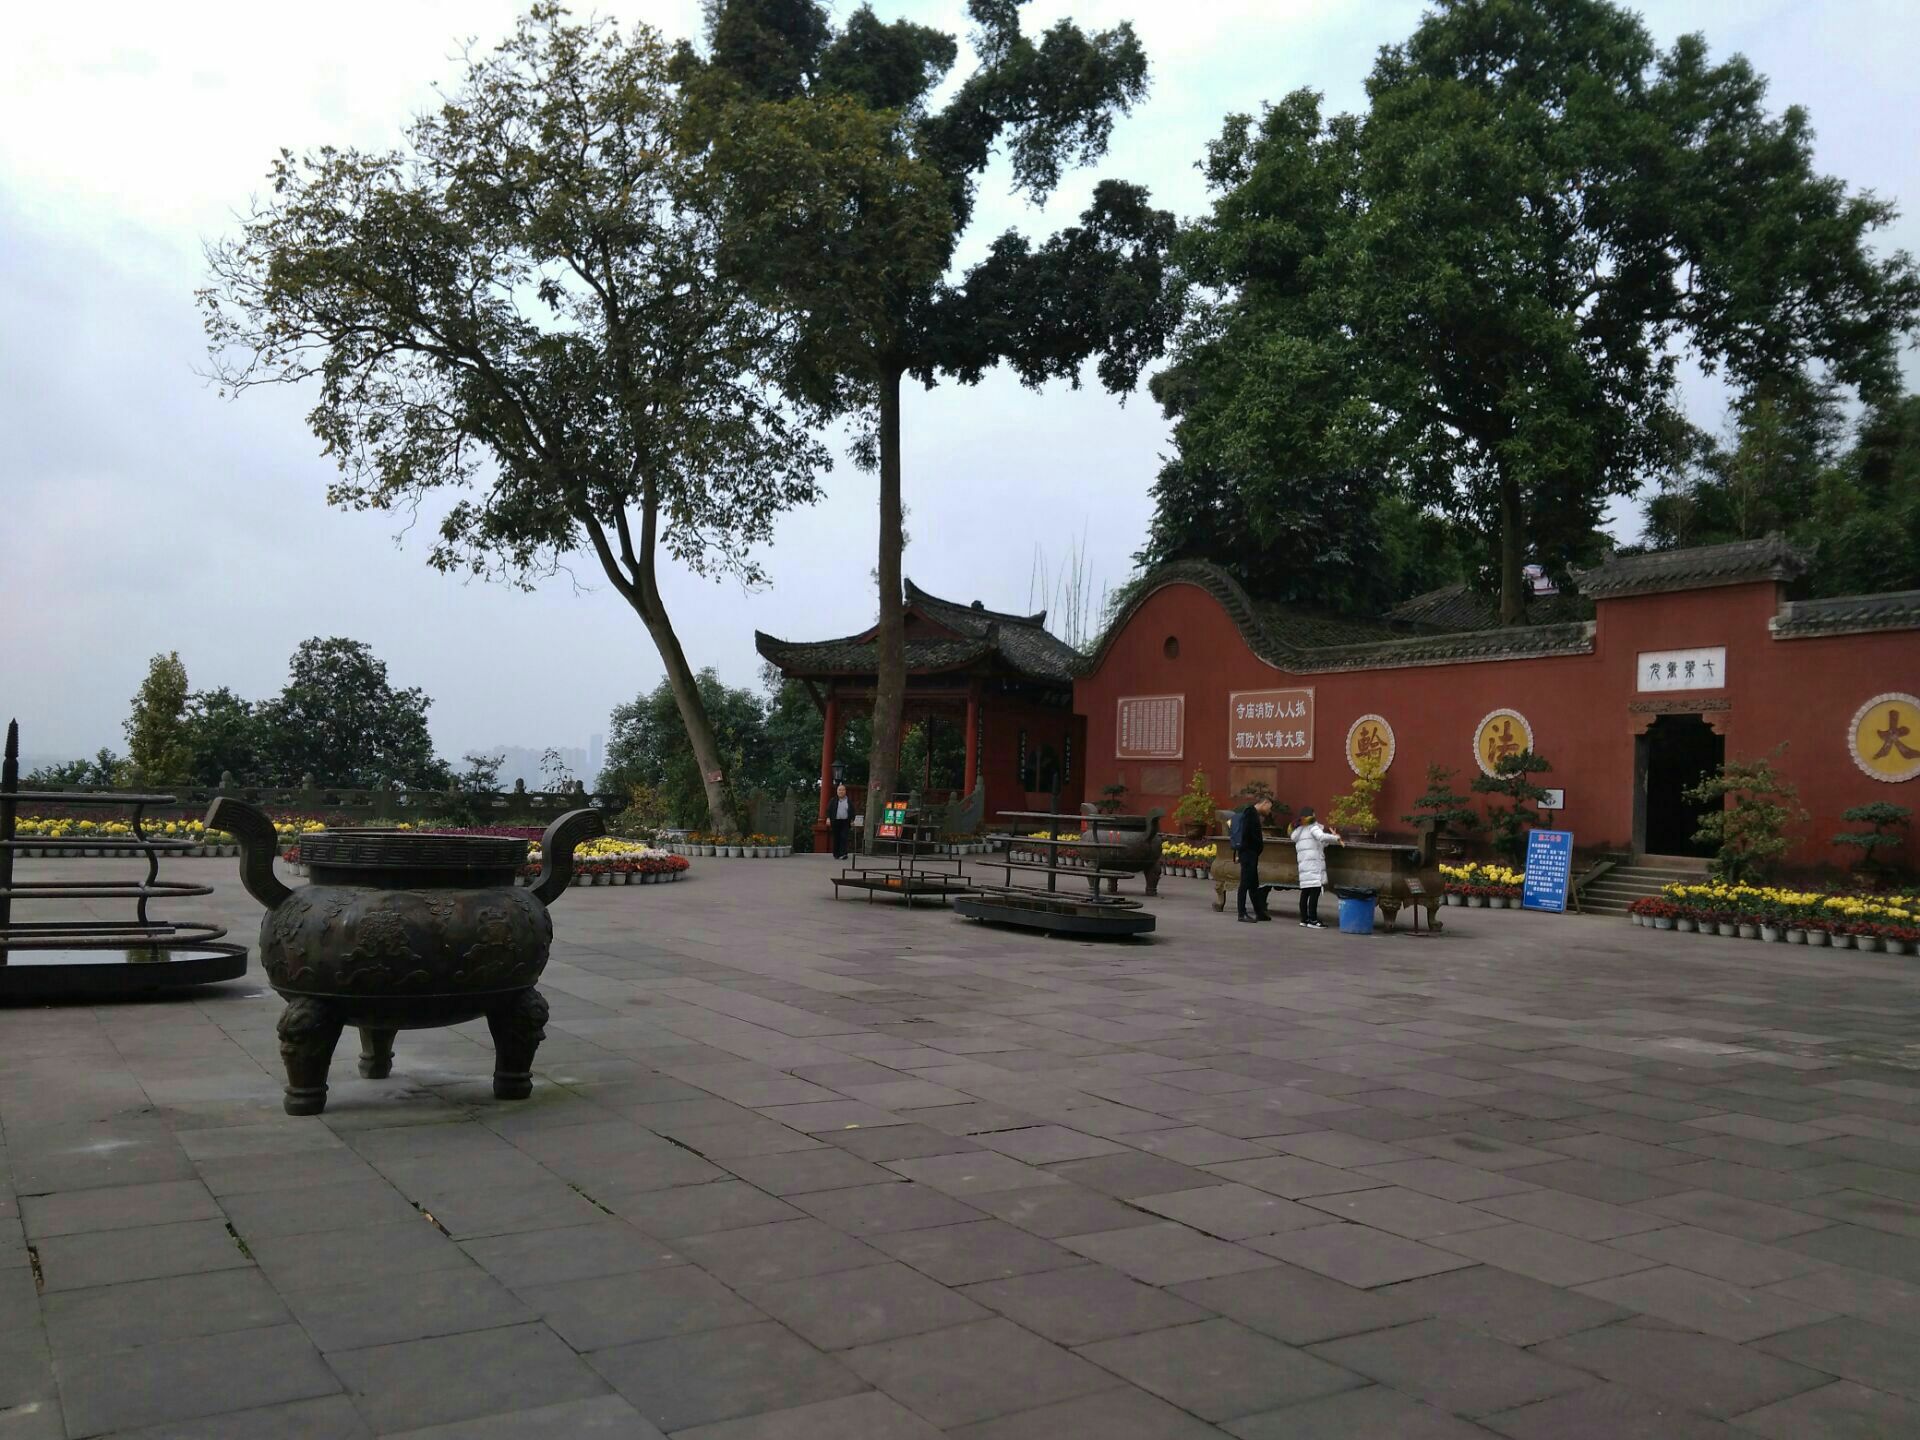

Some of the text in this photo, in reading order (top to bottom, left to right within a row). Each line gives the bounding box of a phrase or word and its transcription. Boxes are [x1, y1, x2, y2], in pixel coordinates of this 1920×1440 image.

[1236, 699, 1306, 719] 寺庙消防人人抓
[1235, 729, 1306, 749] 预防火灾靠大家
[1487, 720, 1520, 763] 法
[1872, 709, 1920, 759] 大
